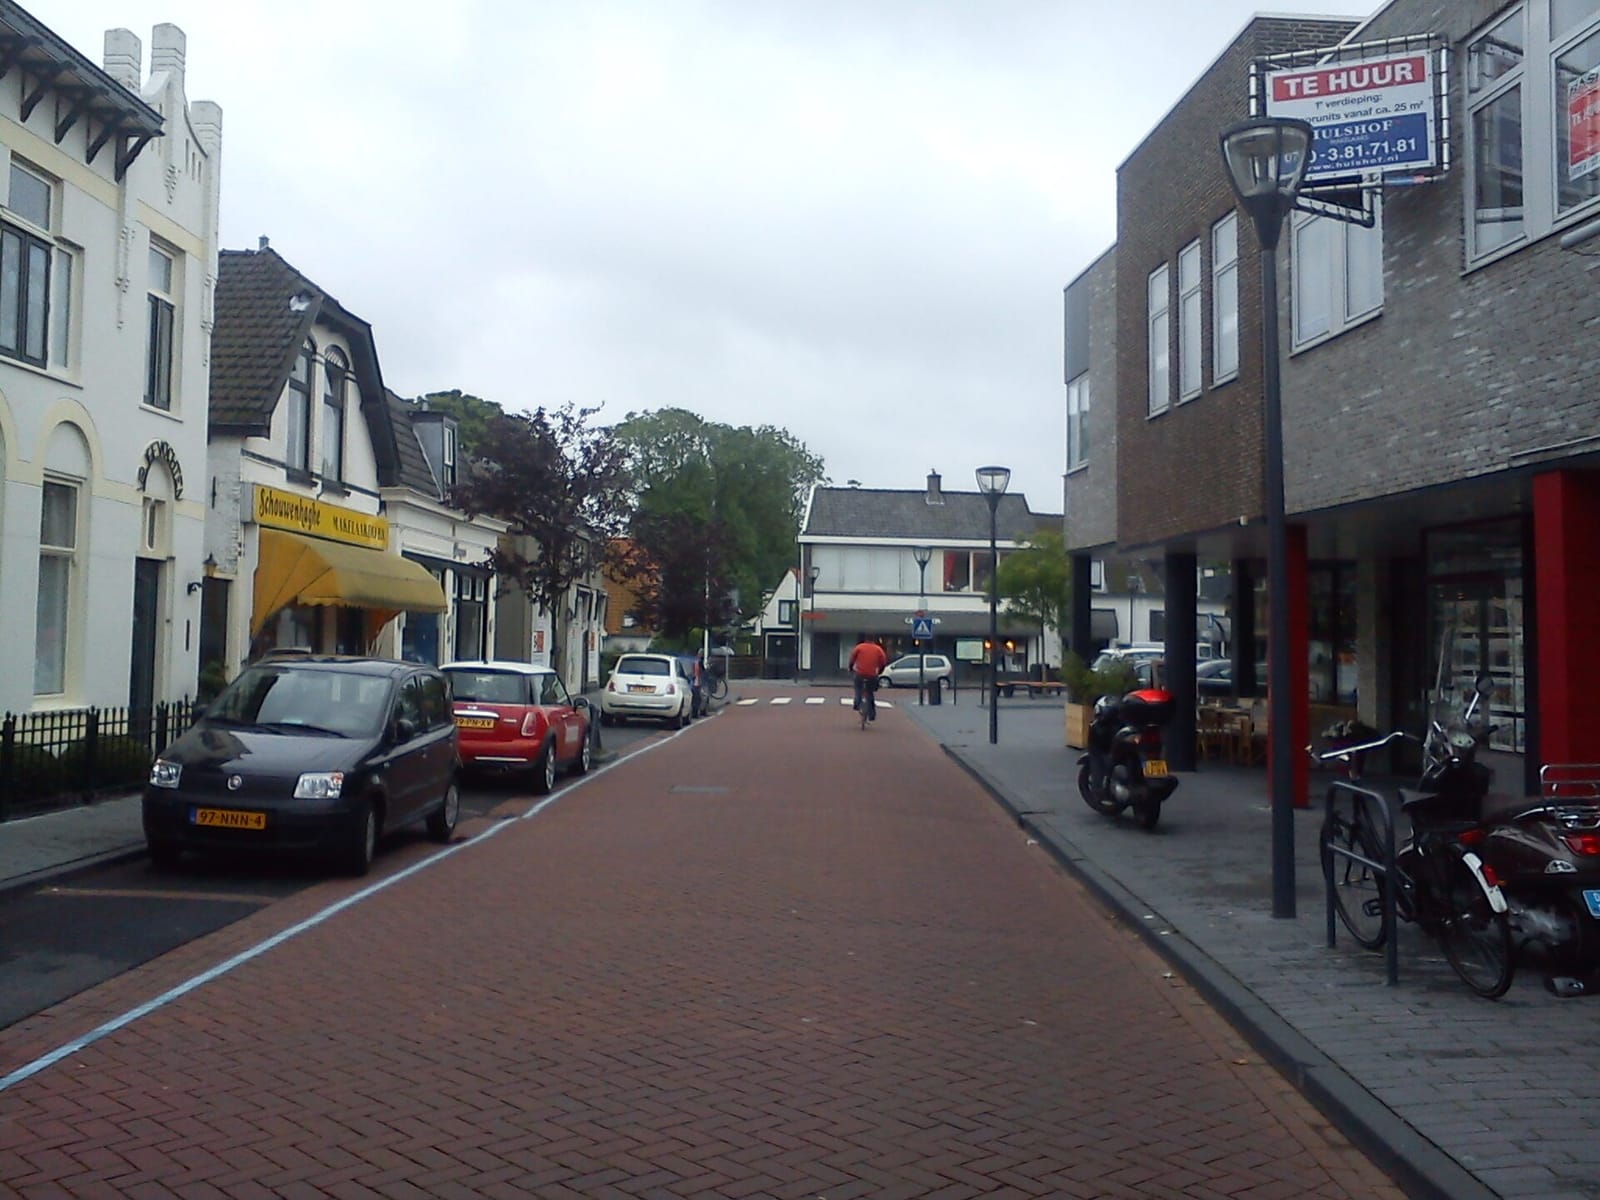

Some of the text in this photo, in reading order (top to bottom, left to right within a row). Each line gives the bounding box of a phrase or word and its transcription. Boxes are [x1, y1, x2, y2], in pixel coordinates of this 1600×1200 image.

[1283, 62, 1414, 97] TE HUUR
[1325, 94, 1383, 109] verdieping:
[1300, 112, 1341, 124] orunits
[1343, 107, 1373, 119] vanaf
[1375, 106, 1391, 114] ca.
[1394, 103, 1407, 112] 25
[1307, 153, 1399, 172] ww.hulshof.nl
[199, 811, 263, 827] 97-NNN-4
